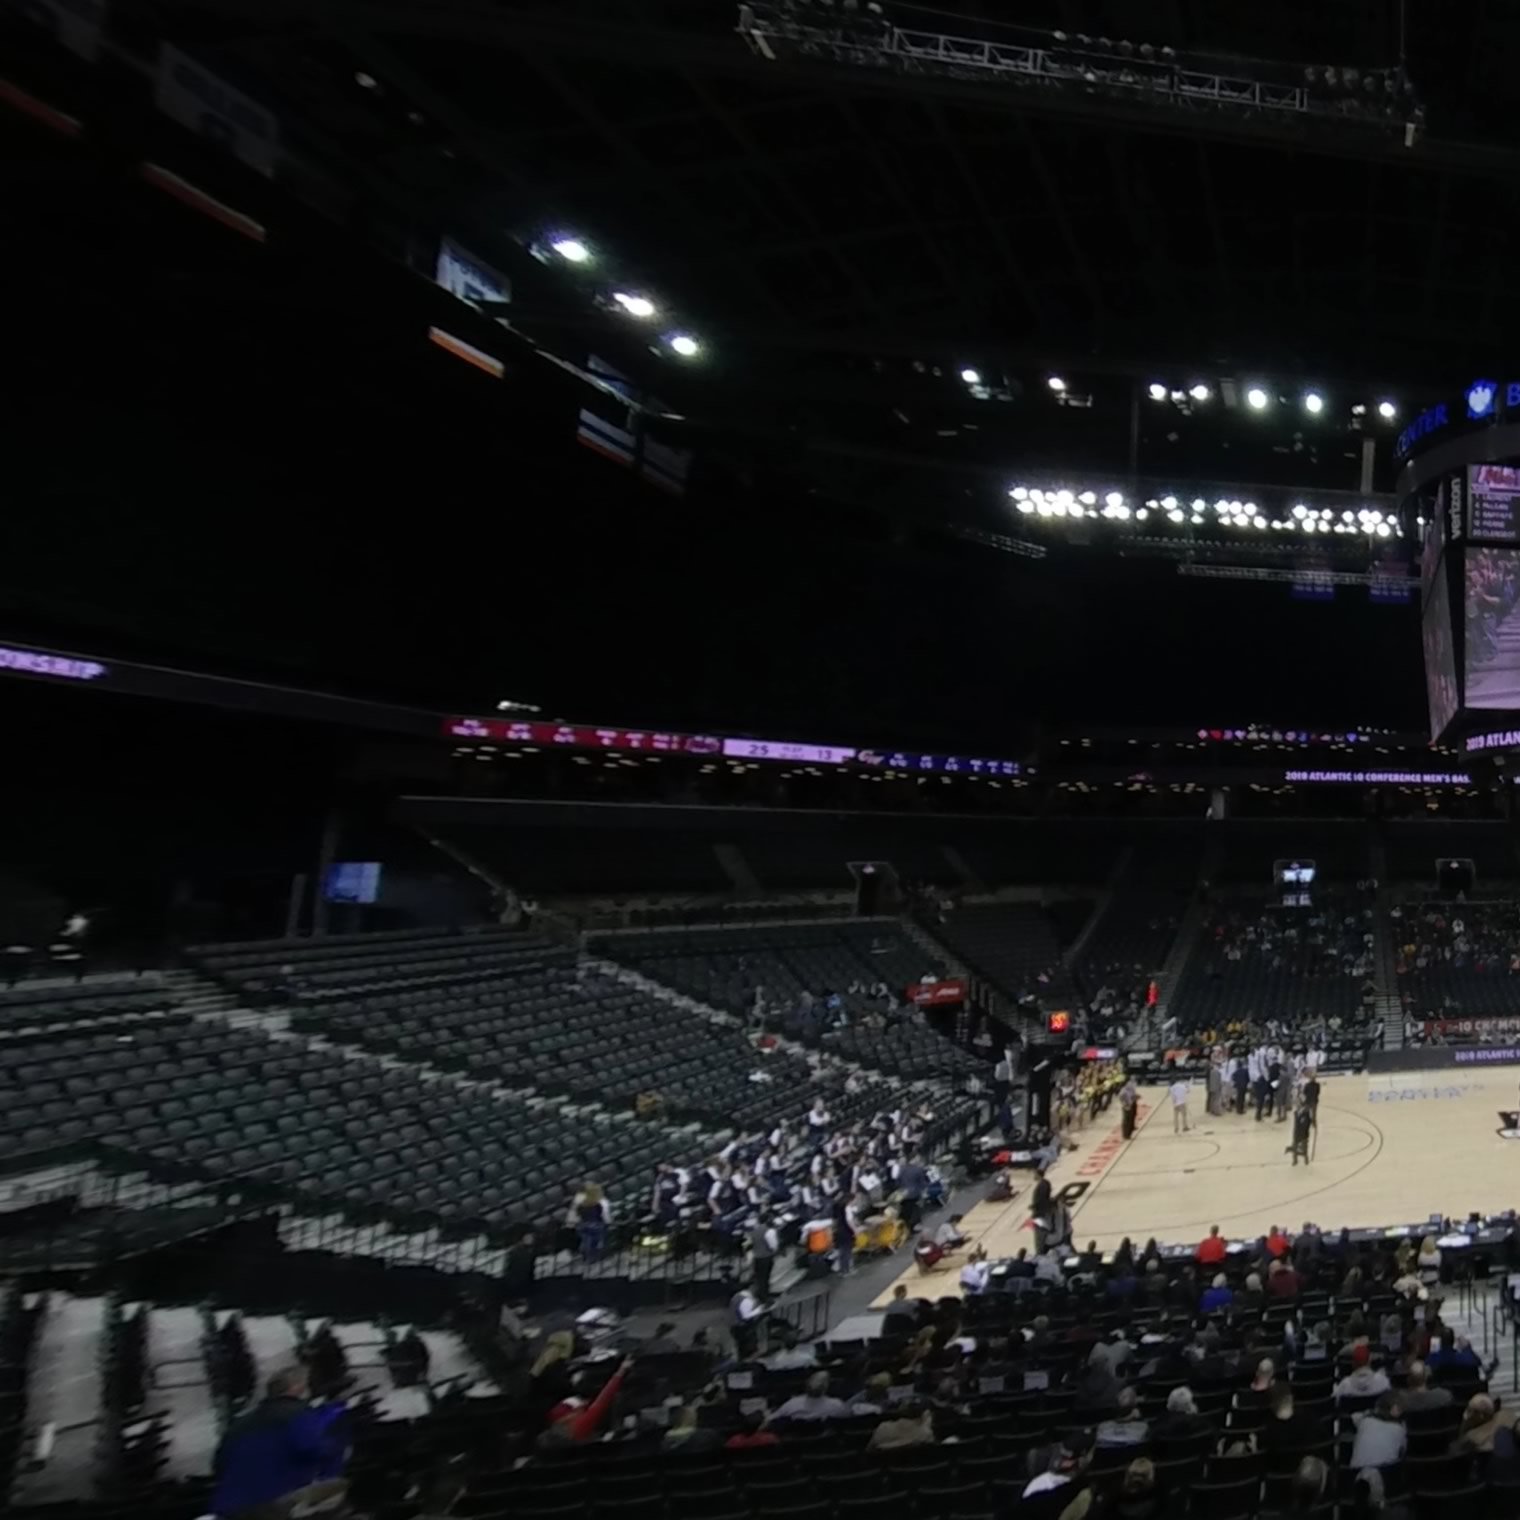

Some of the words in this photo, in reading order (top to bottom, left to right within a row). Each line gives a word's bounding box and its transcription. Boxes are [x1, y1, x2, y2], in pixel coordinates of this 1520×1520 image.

[1449, 477, 1462, 541] verizon
[1466, 735, 1485, 752] 2019
[817, 750, 832, 761] 13
[1309, 771, 1352, 782] ATLANTIC
[1364, 772, 1421, 783] CONFERENCE
[1422, 773, 1450, 784] MEN'S
[1476, 1048, 1515, 1060] ATLANTIC
